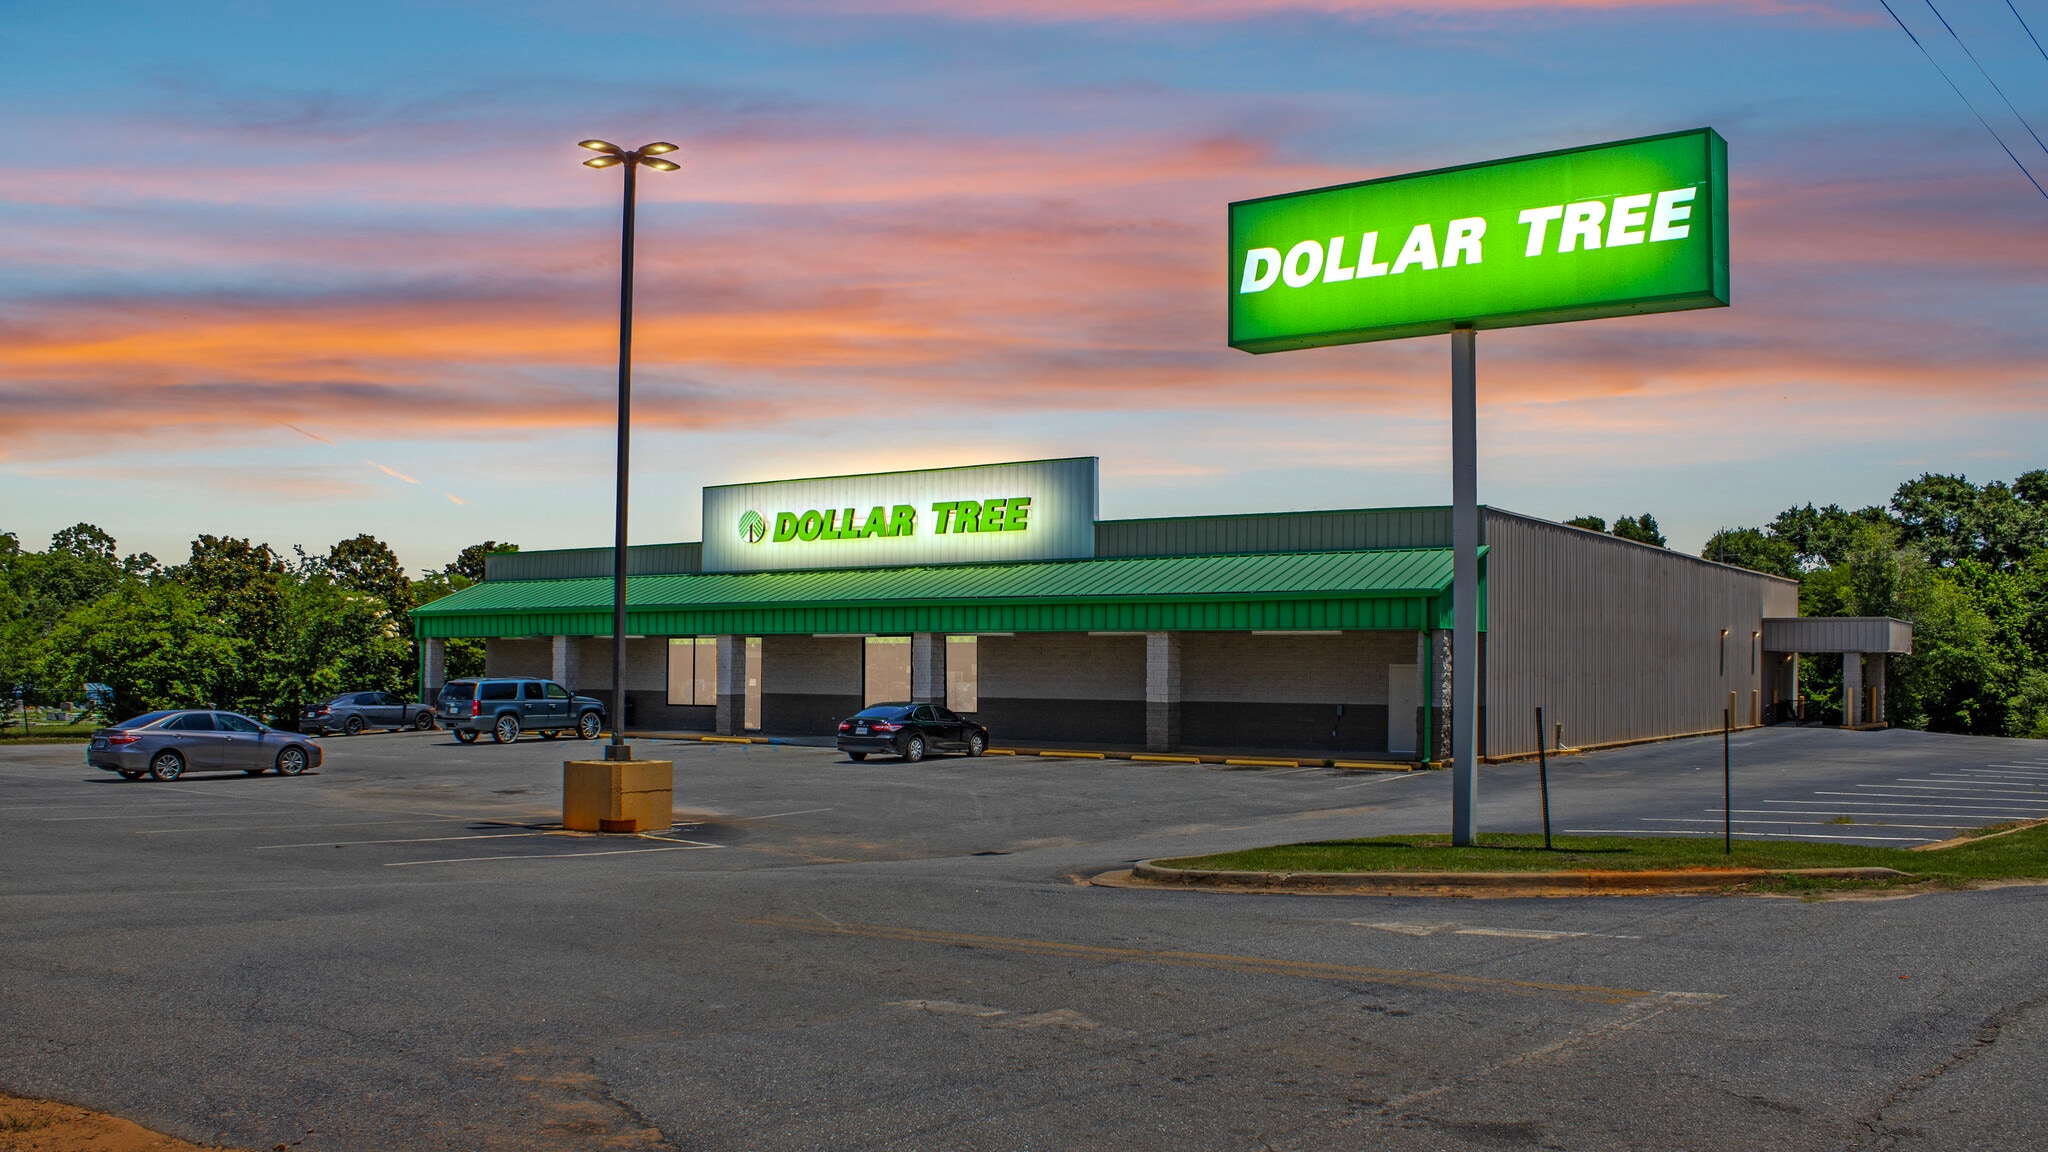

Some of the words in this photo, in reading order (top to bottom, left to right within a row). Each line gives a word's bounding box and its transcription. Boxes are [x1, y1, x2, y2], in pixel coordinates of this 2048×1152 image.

[1240, 216, 1487, 294] DOLLAR
[1517, 186, 1697, 257] TREE
[772, 504, 917, 543] DOLLAR
[931, 497, 1032, 535] TREE
